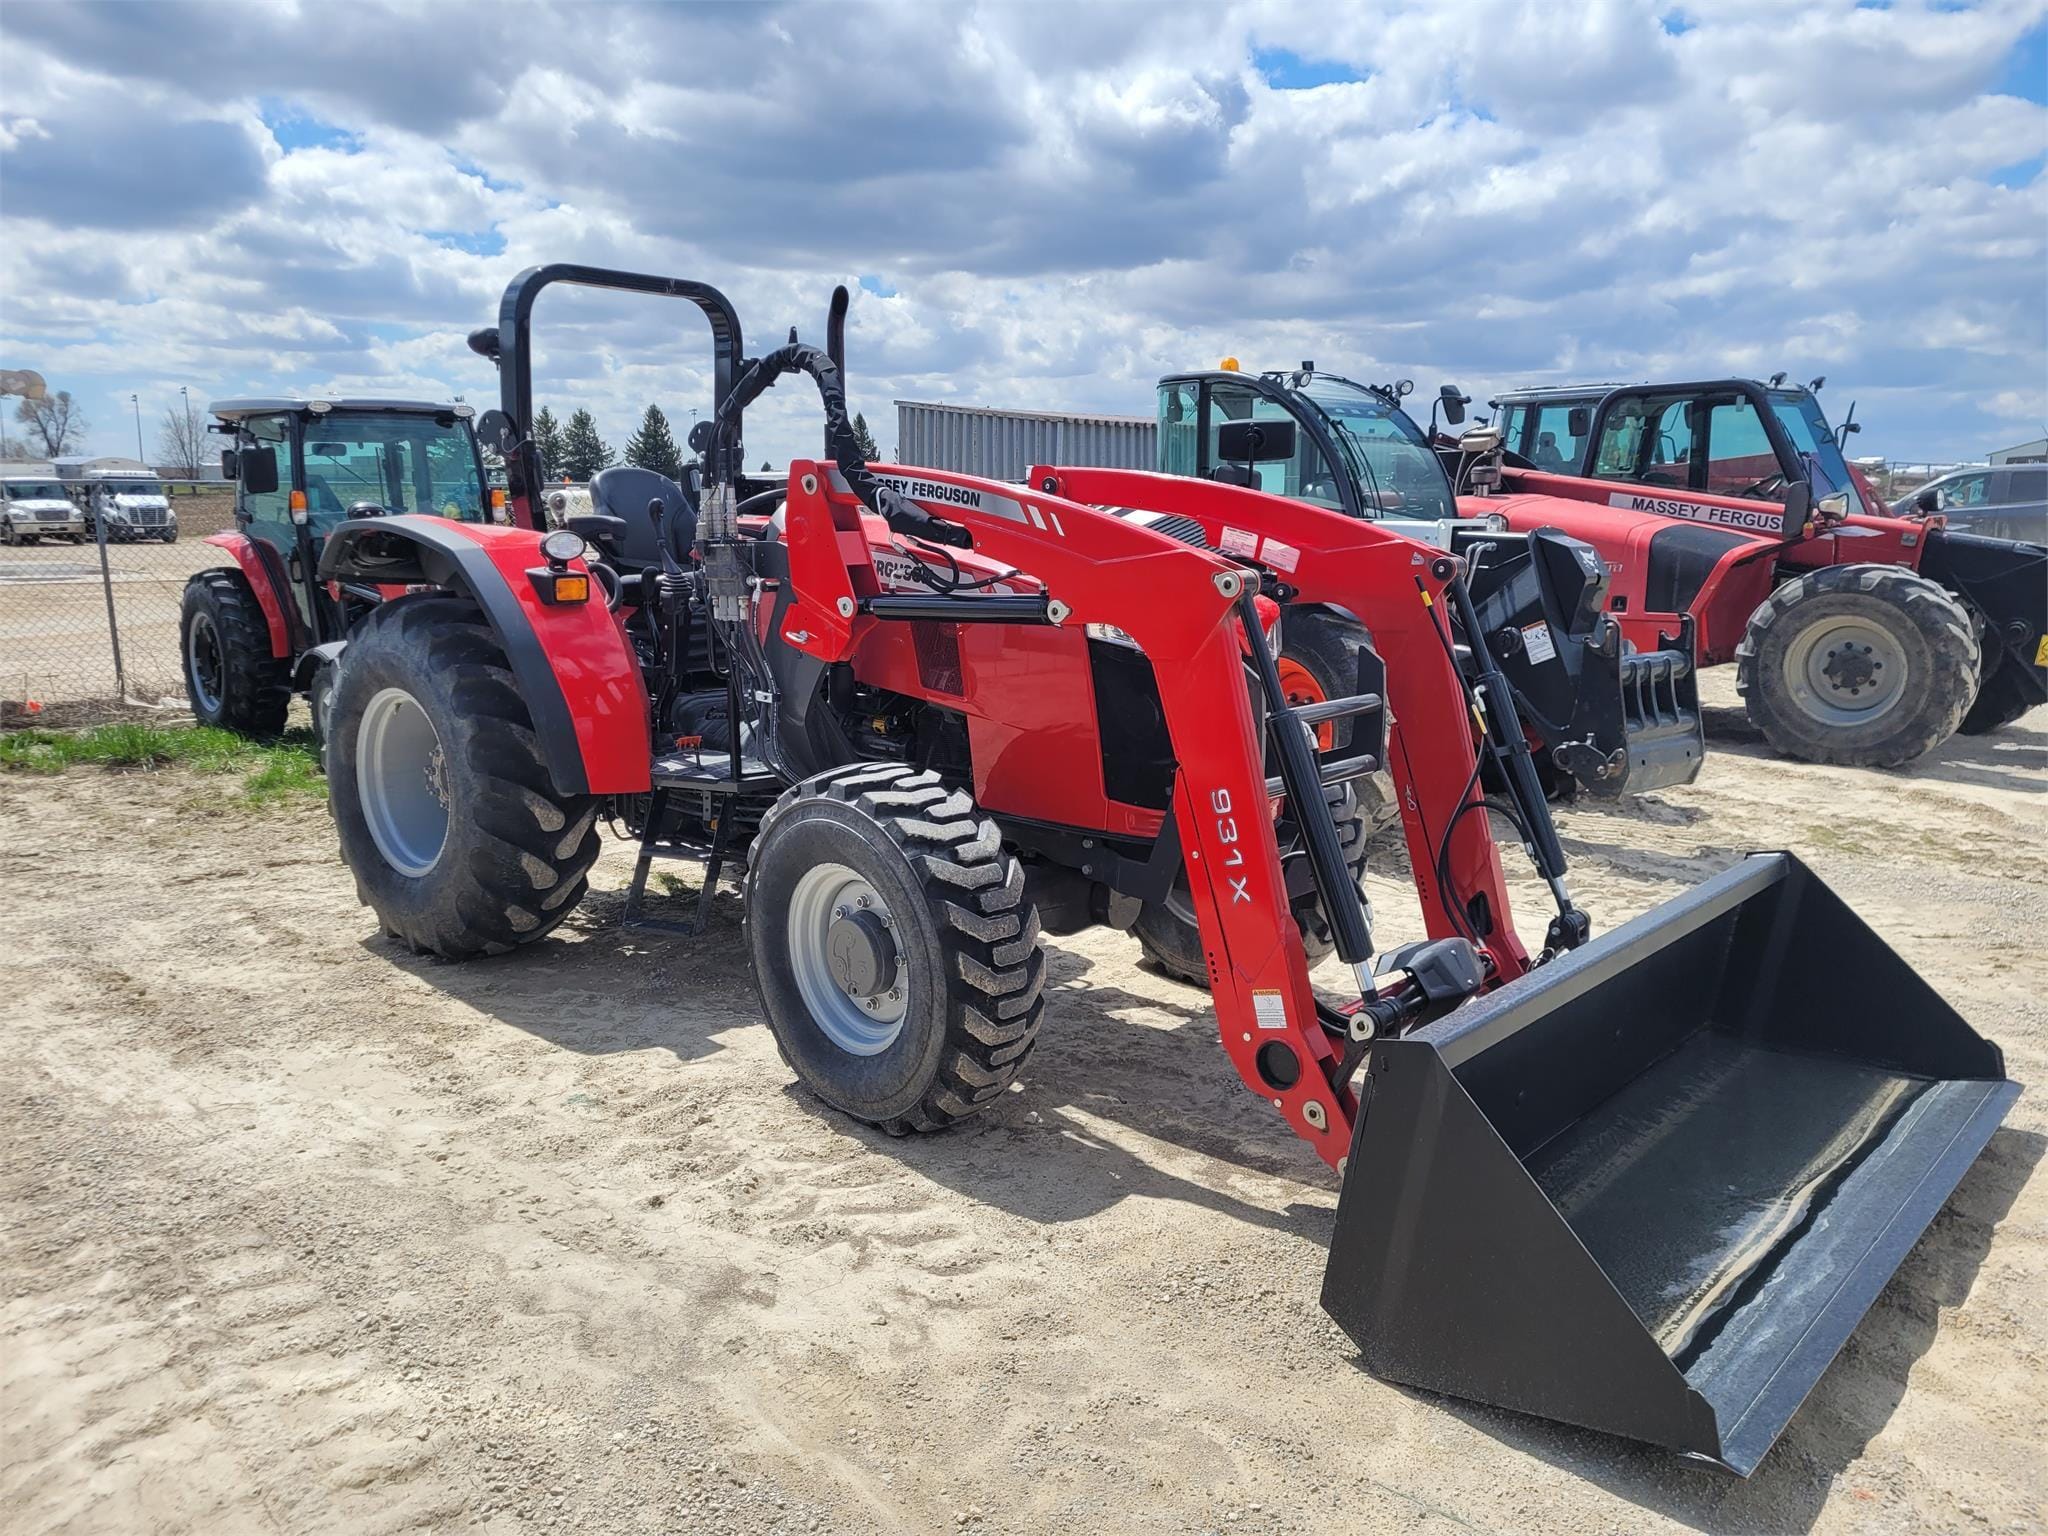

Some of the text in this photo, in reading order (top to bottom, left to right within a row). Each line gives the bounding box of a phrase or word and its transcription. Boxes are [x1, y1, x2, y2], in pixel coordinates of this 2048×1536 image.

[912, 482, 981, 507] FERGUSON
[1631, 497, 1785, 530] MASSEY FERGUS
[1211, 788, 1251, 904] 931X
